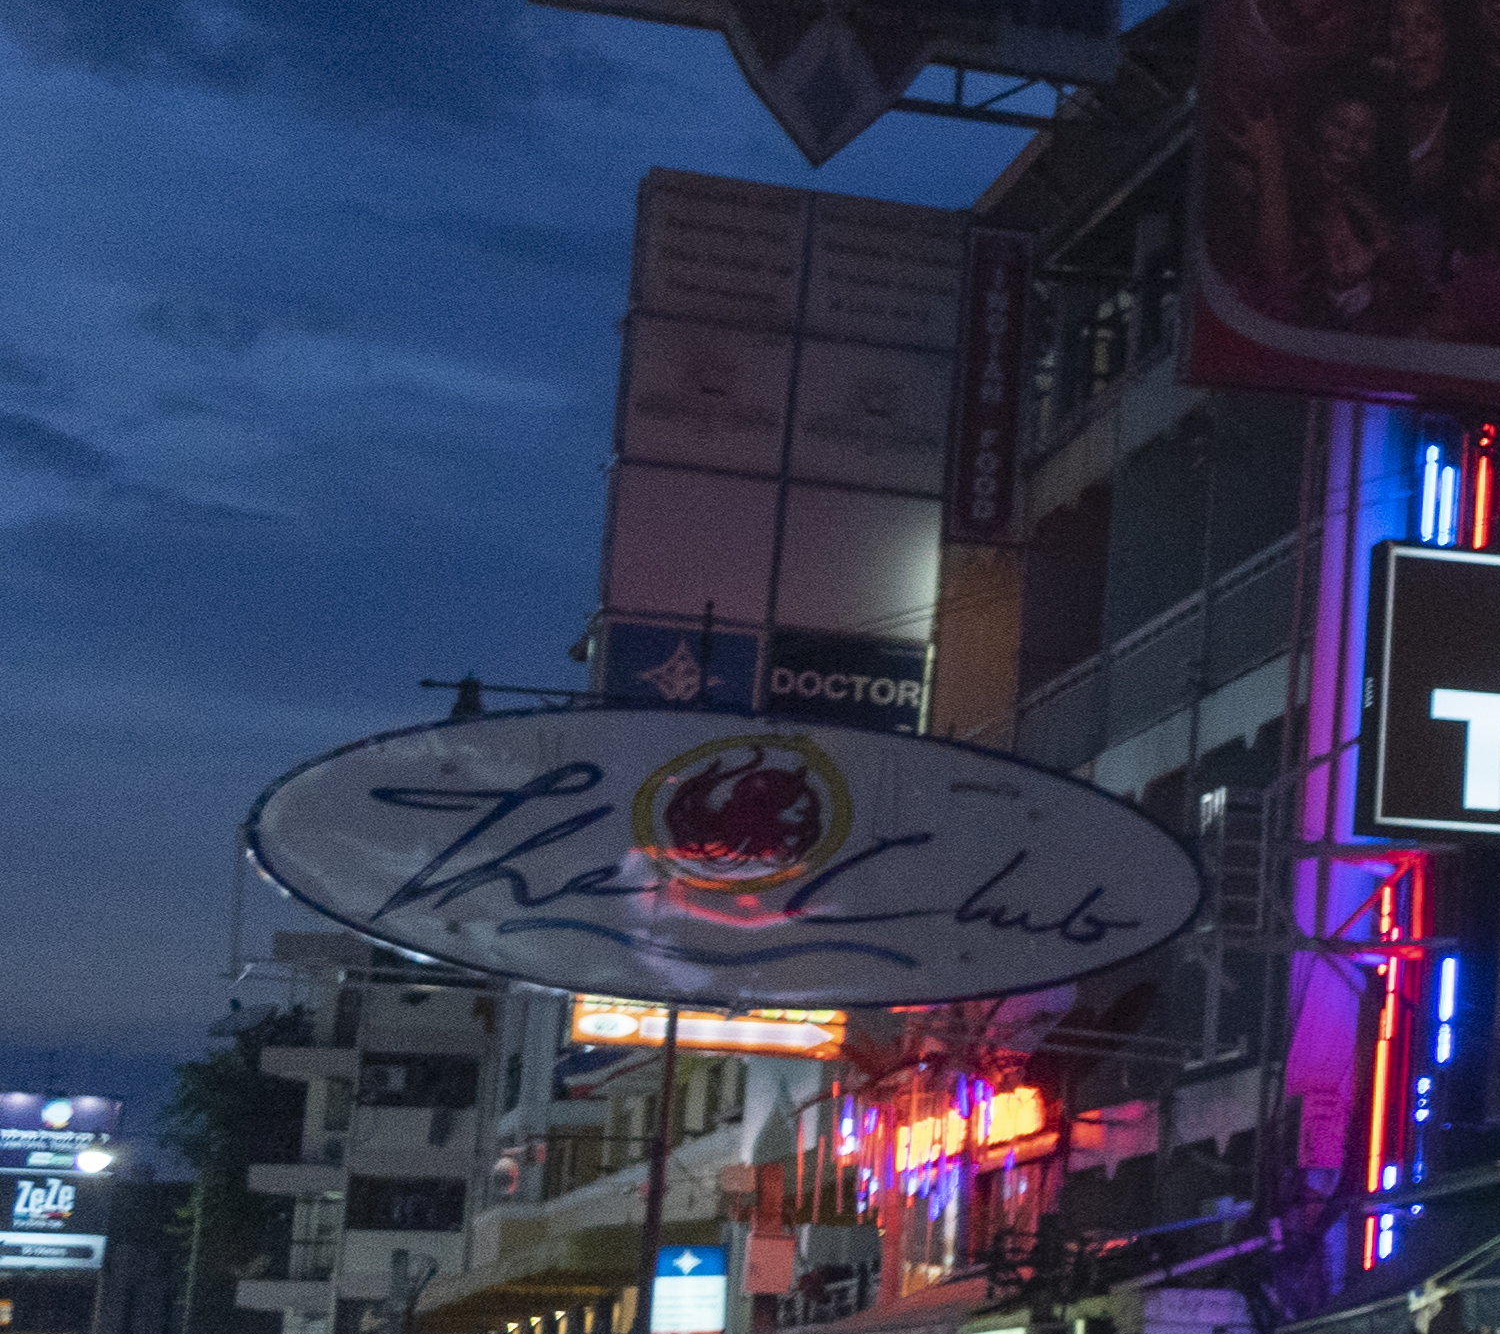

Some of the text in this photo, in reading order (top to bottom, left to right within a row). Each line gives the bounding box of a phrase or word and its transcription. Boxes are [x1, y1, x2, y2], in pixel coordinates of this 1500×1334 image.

[972, 428, 999, 519] FOOD
[771, 668, 921, 708] DOCTOR
[14, 1178, 76, 1214] ZeZe
